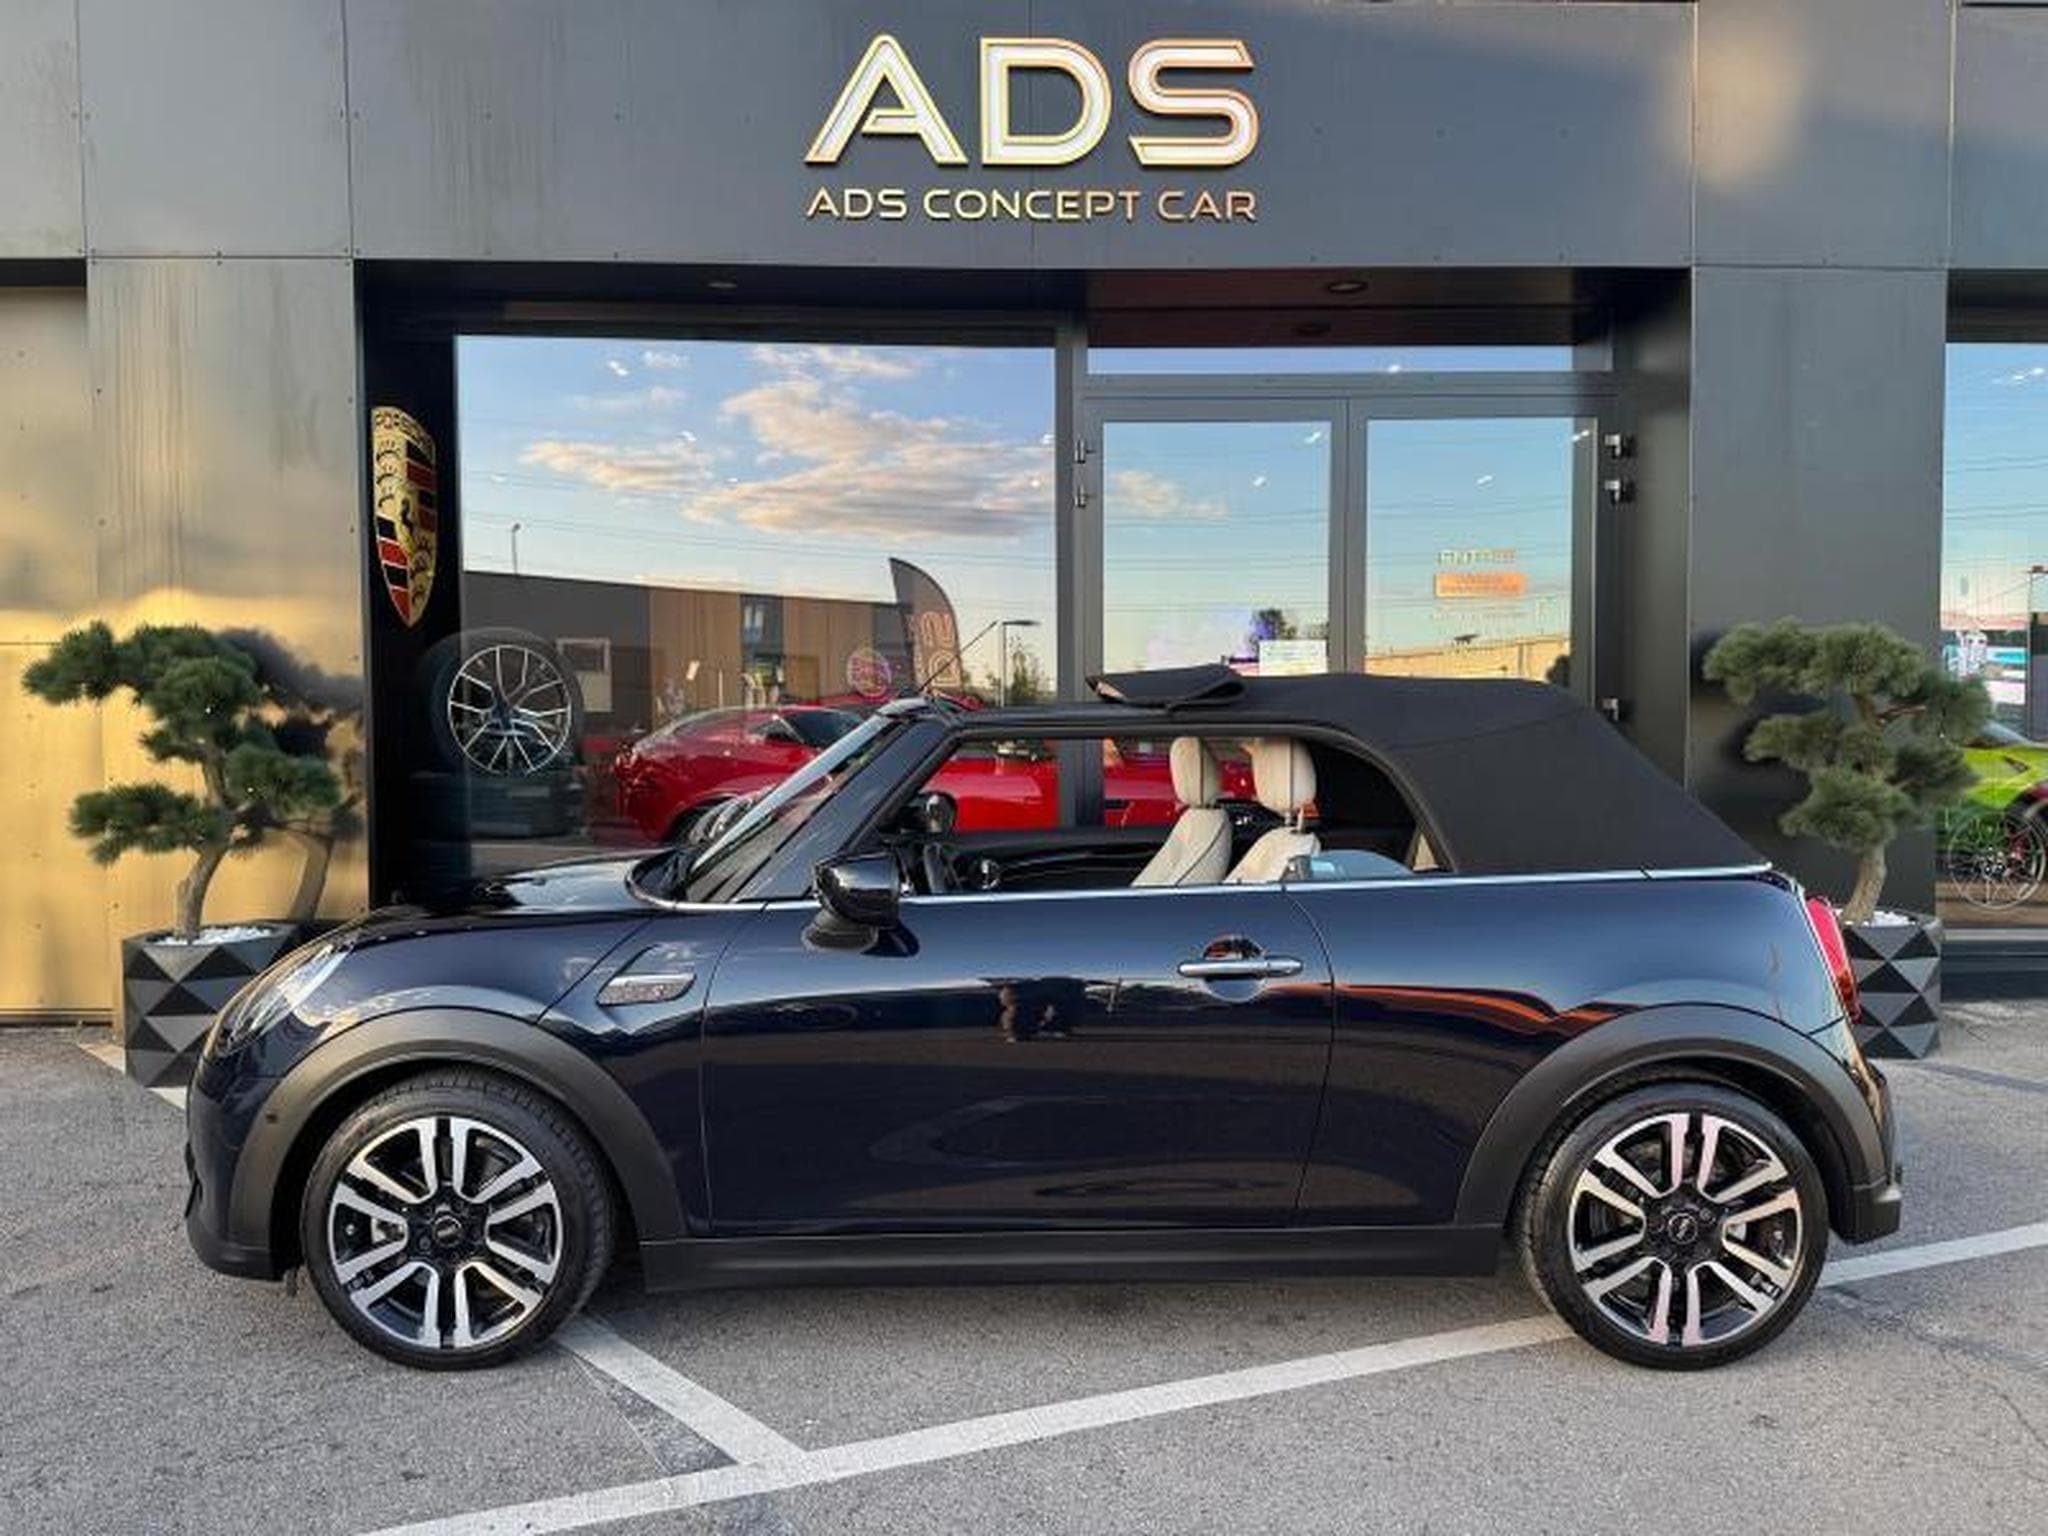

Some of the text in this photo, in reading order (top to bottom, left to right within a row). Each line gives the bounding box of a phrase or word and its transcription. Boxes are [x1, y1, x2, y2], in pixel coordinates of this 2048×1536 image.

[804, 34, 1260, 167] ADS
[806, 188, 1258, 222] ADS CONCEPT CAR
